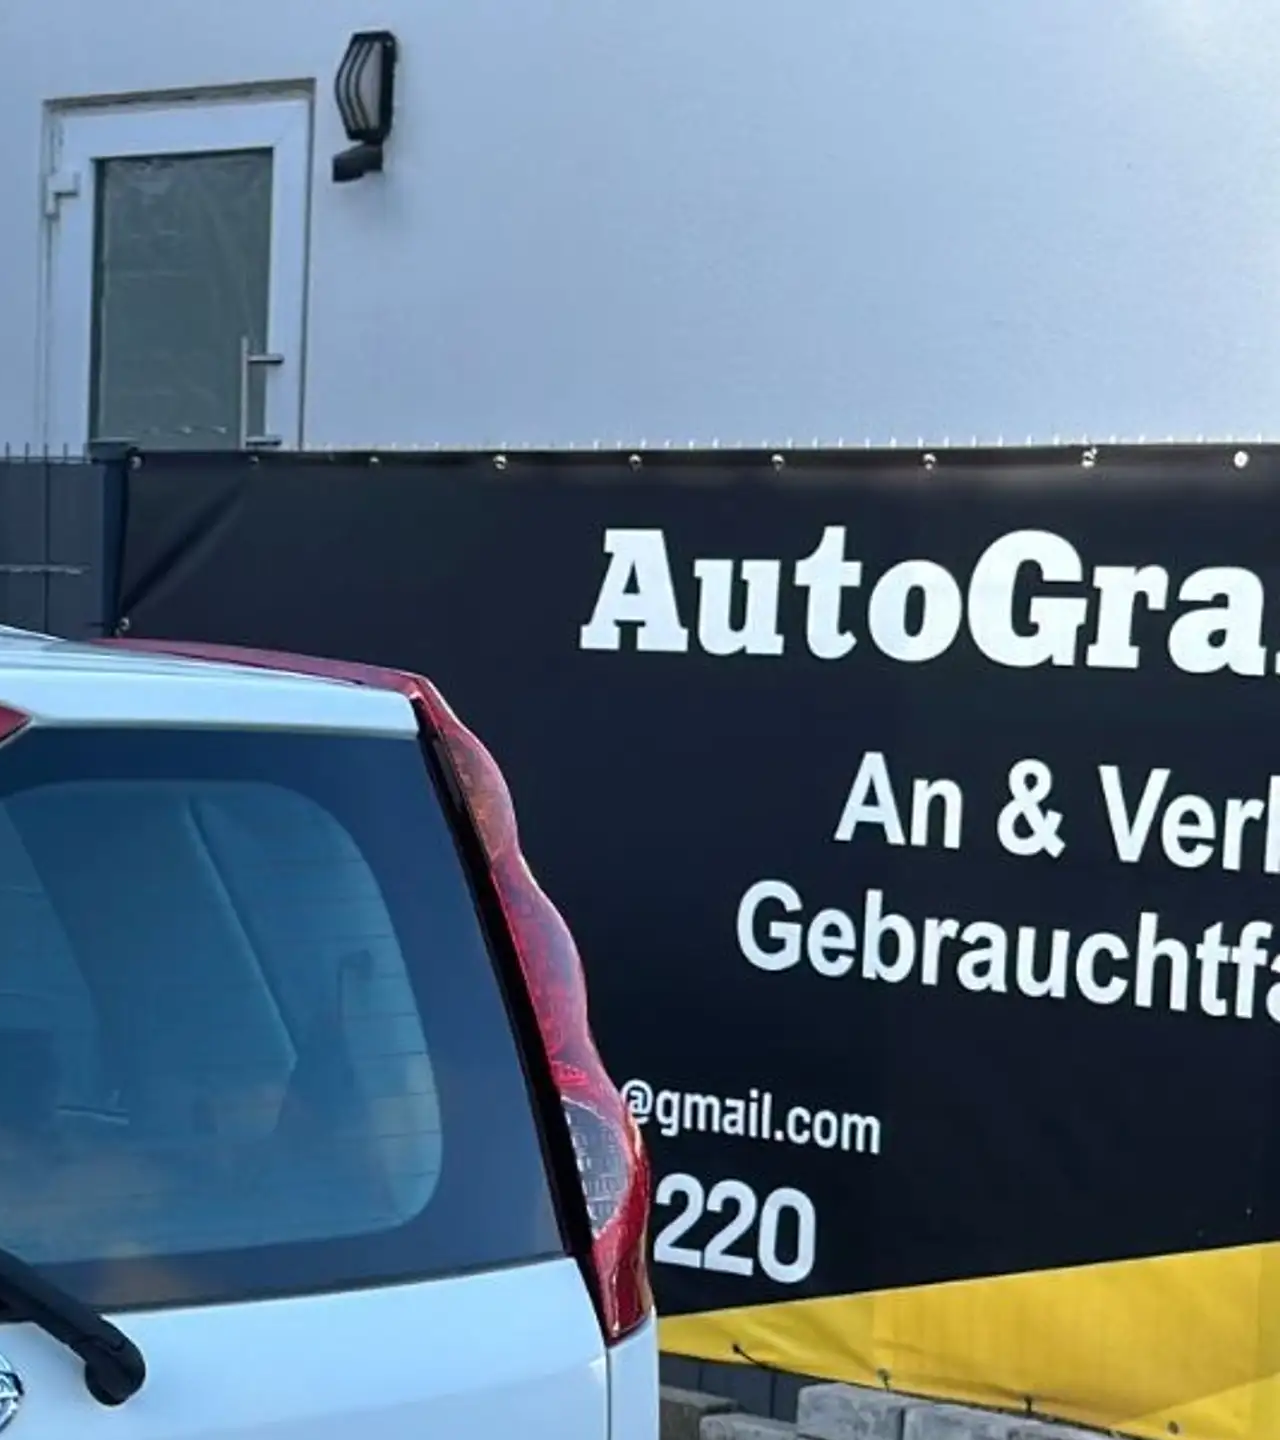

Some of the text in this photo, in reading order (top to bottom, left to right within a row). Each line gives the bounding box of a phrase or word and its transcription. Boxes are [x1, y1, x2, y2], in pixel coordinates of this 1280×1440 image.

[580, 525, 1280, 676] AutoGra
[834, 751, 962, 849] An
[997, 758, 1066, 857] &
[622, 1079, 881, 1153] @gmail.com
[653, 1172, 816, 1284] 220
